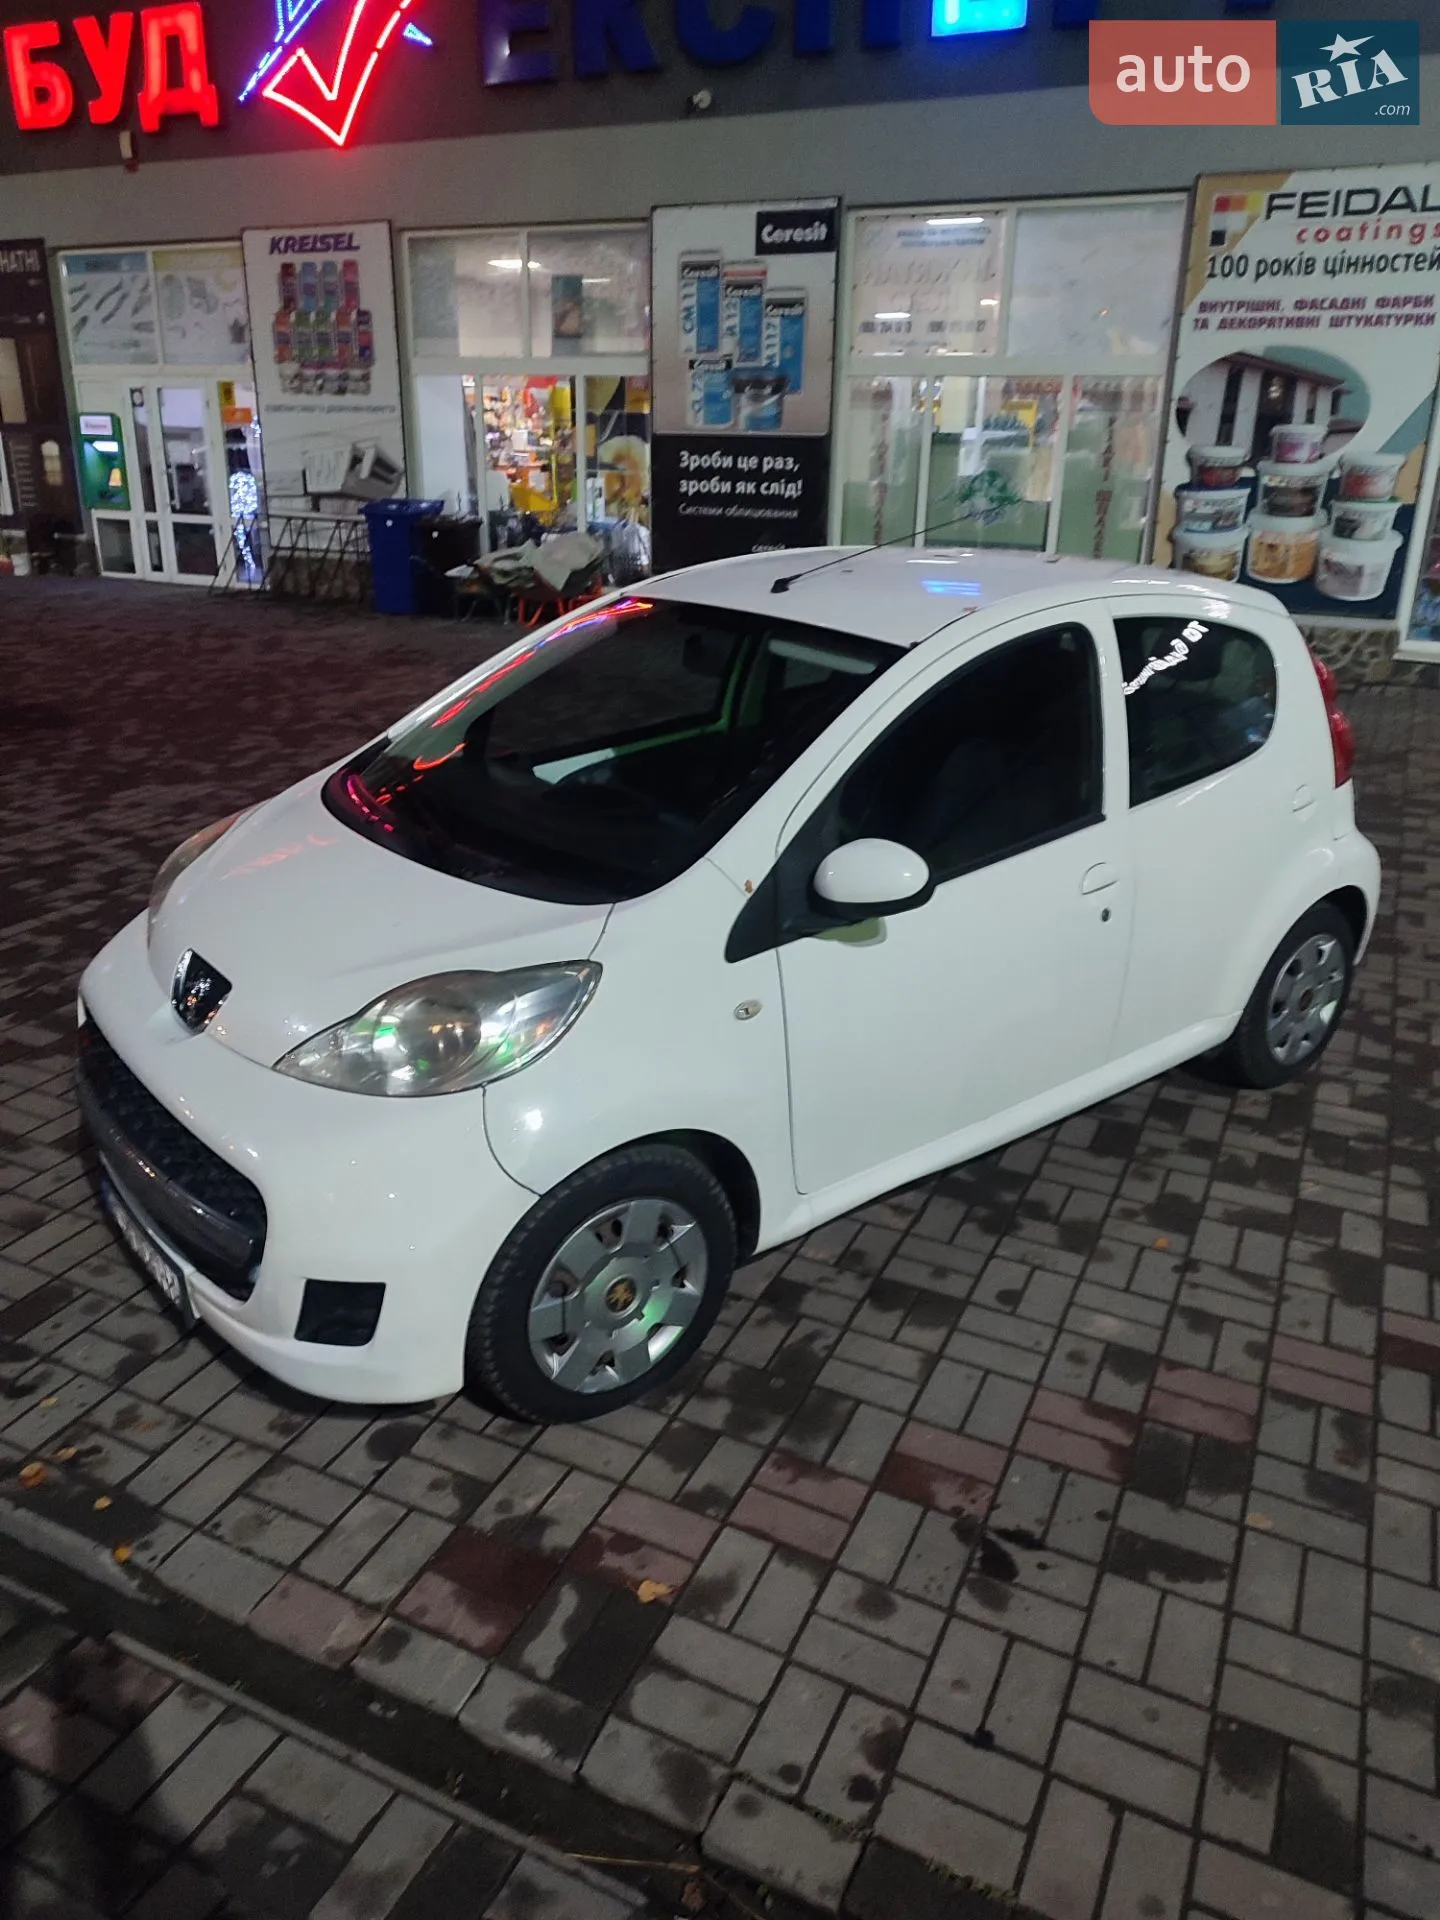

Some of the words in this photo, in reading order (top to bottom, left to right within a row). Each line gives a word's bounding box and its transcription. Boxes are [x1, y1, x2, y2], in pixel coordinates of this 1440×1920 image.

[4, 2, 219, 132] БУД
[1265, 184, 1440, 220] FEIDAL
[269, 232, 360, 255] KREISEL
[761, 221, 828, 244] Ceresit
[1296, 218, 1440, 246] coatings
[1207, 253, 1249, 280] 100
[1254, 251, 1316, 283] років
[1324, 246, 1440, 280] цінностей
[1293, 297, 1366, 311] ФАСАДНІ
[1375, 294, 1434, 309] ФАРБИ
[1193, 317, 1209, 331] ТА
[1217, 315, 1320, 330] ДЕКОРАТИВНІ
[1329, 313, 1436, 329] ШТУКАТУРКИ
[679, 450, 733, 472] Зроби
[737, 456, 759, 472] це
[762, 456, 800, 473] раз,
[679, 476, 732, 496] зроби
[735, 481, 757, 495] як
[760, 478, 803, 499] слід!
